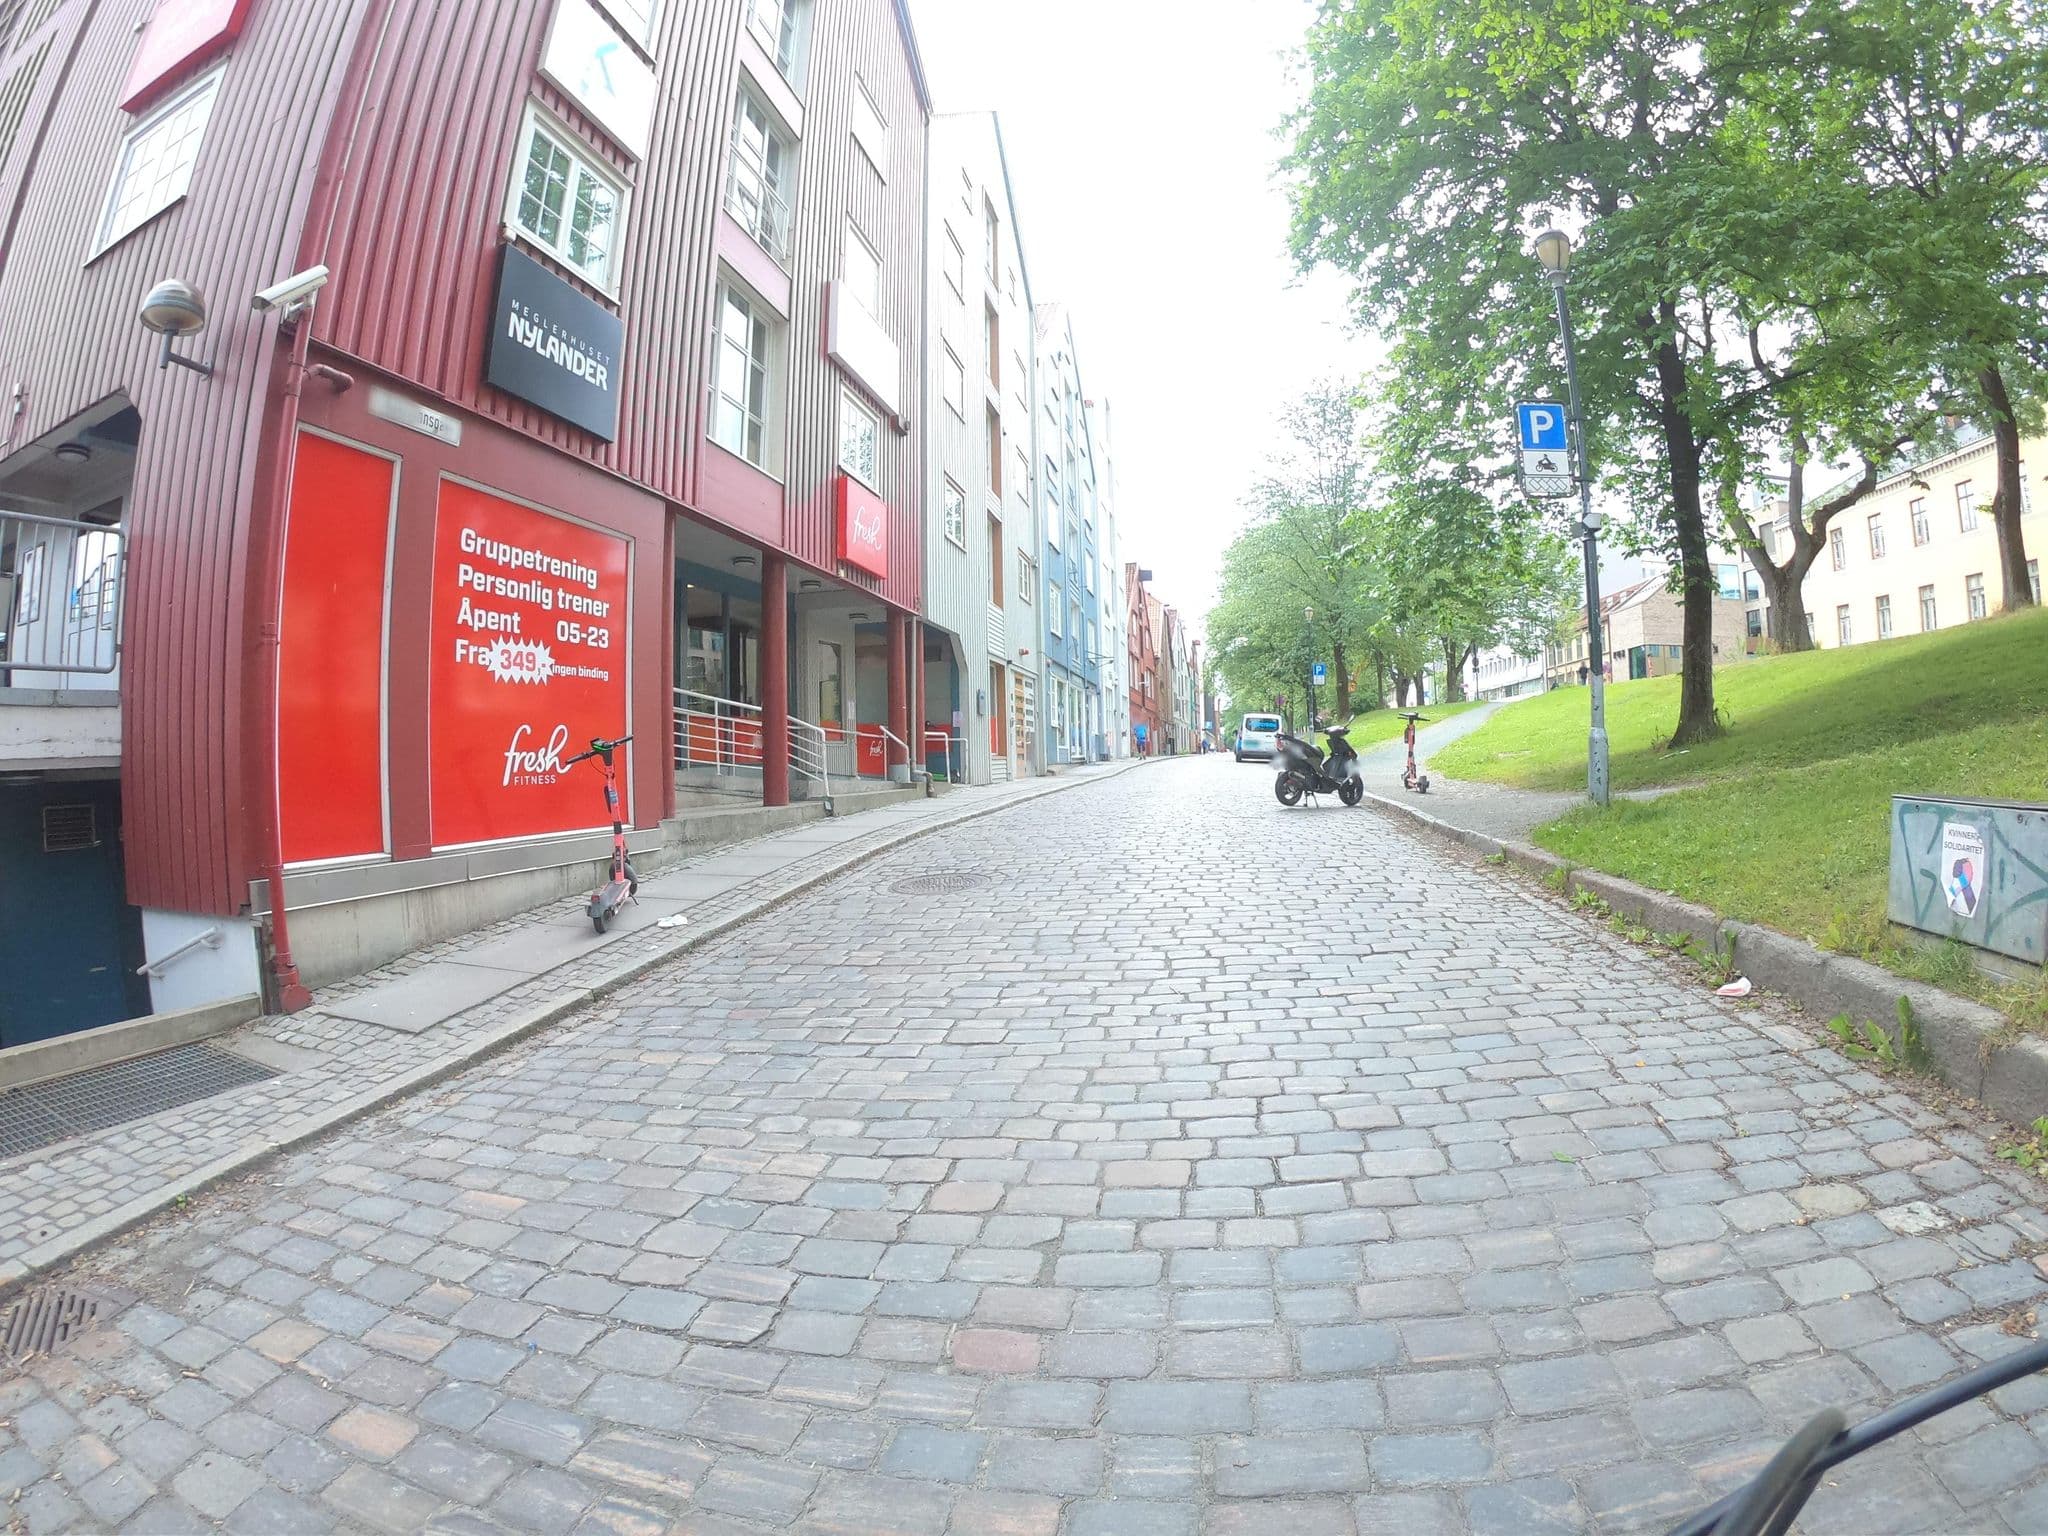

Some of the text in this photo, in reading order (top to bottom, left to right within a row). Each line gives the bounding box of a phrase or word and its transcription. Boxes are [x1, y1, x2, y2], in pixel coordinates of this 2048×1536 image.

[508, 311, 608, 391] NYLANDER
[511, 299, 611, 365] MEGLERHUSET
[1529, 410, 1554, 444] P
[852, 505, 882, 551] fresh
[460, 527, 597, 590] Gruppetrening
[458, 563, 610, 618] Personlig trener
[456, 597, 609, 649] Åpent 05-23
[455, 638, 490, 666] Fra
[551, 662, 577, 677] ingen
[578, 665, 609, 682] binding
[502, 724, 572, 787] fresh
[514, 774, 556, 786] FITNESS
